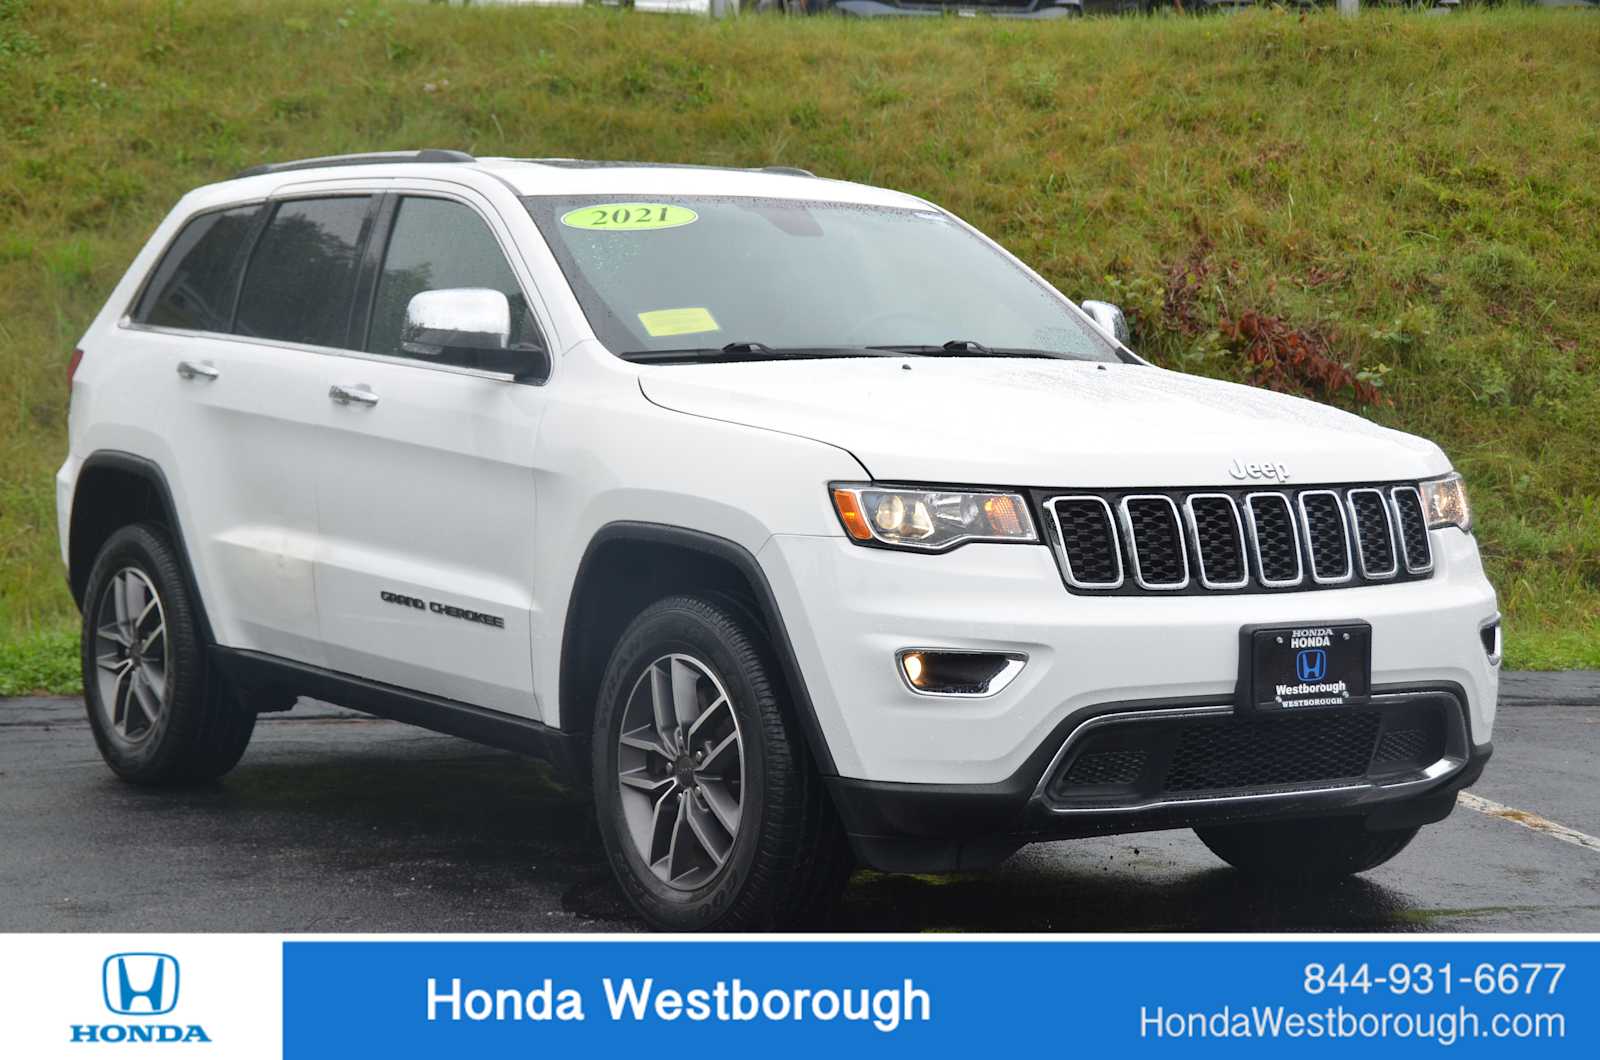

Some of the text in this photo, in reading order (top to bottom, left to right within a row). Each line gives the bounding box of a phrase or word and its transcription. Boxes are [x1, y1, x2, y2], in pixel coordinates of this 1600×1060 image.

[591, 206, 669, 226] 2021
[1229, 457, 1290, 484] Jeep
[380, 590, 505, 629] GRAND CHEROKEE
[1291, 628, 1334, 638] HONDA
[1290, 636, 1331, 649] HONDA
[1275, 680, 1346, 696] Westborough
[1281, 697, 1343, 708] WESTBOROUGH
